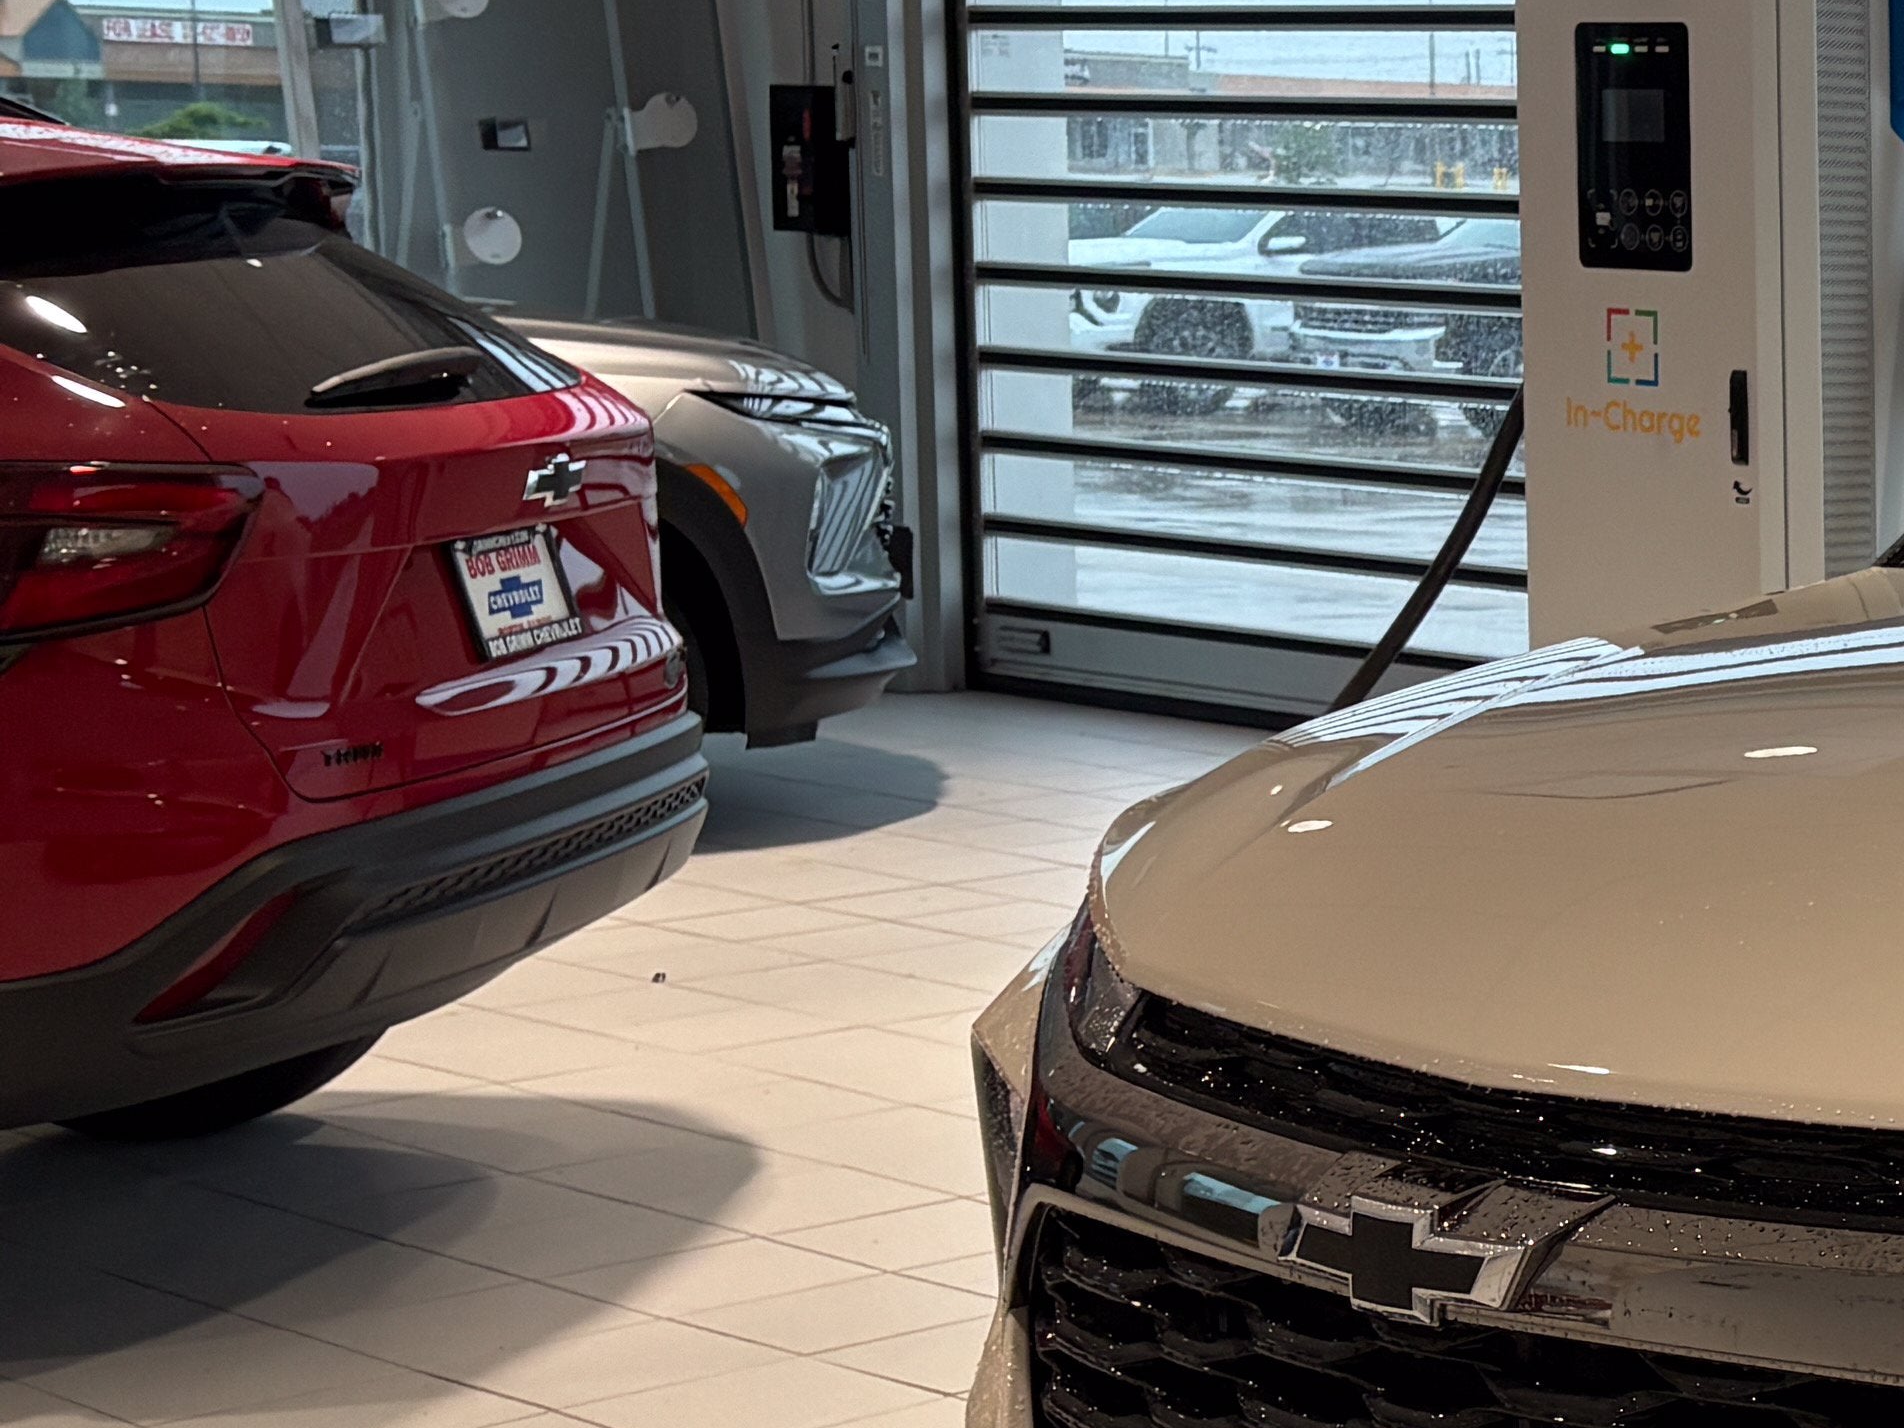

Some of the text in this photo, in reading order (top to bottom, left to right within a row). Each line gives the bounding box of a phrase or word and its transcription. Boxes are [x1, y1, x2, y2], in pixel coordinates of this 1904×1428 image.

[1566, 396, 1701, 444] In-Charge
[465, 544, 542, 580] BOB GRIMM
[489, 585, 542, 610] CHEVROLET
